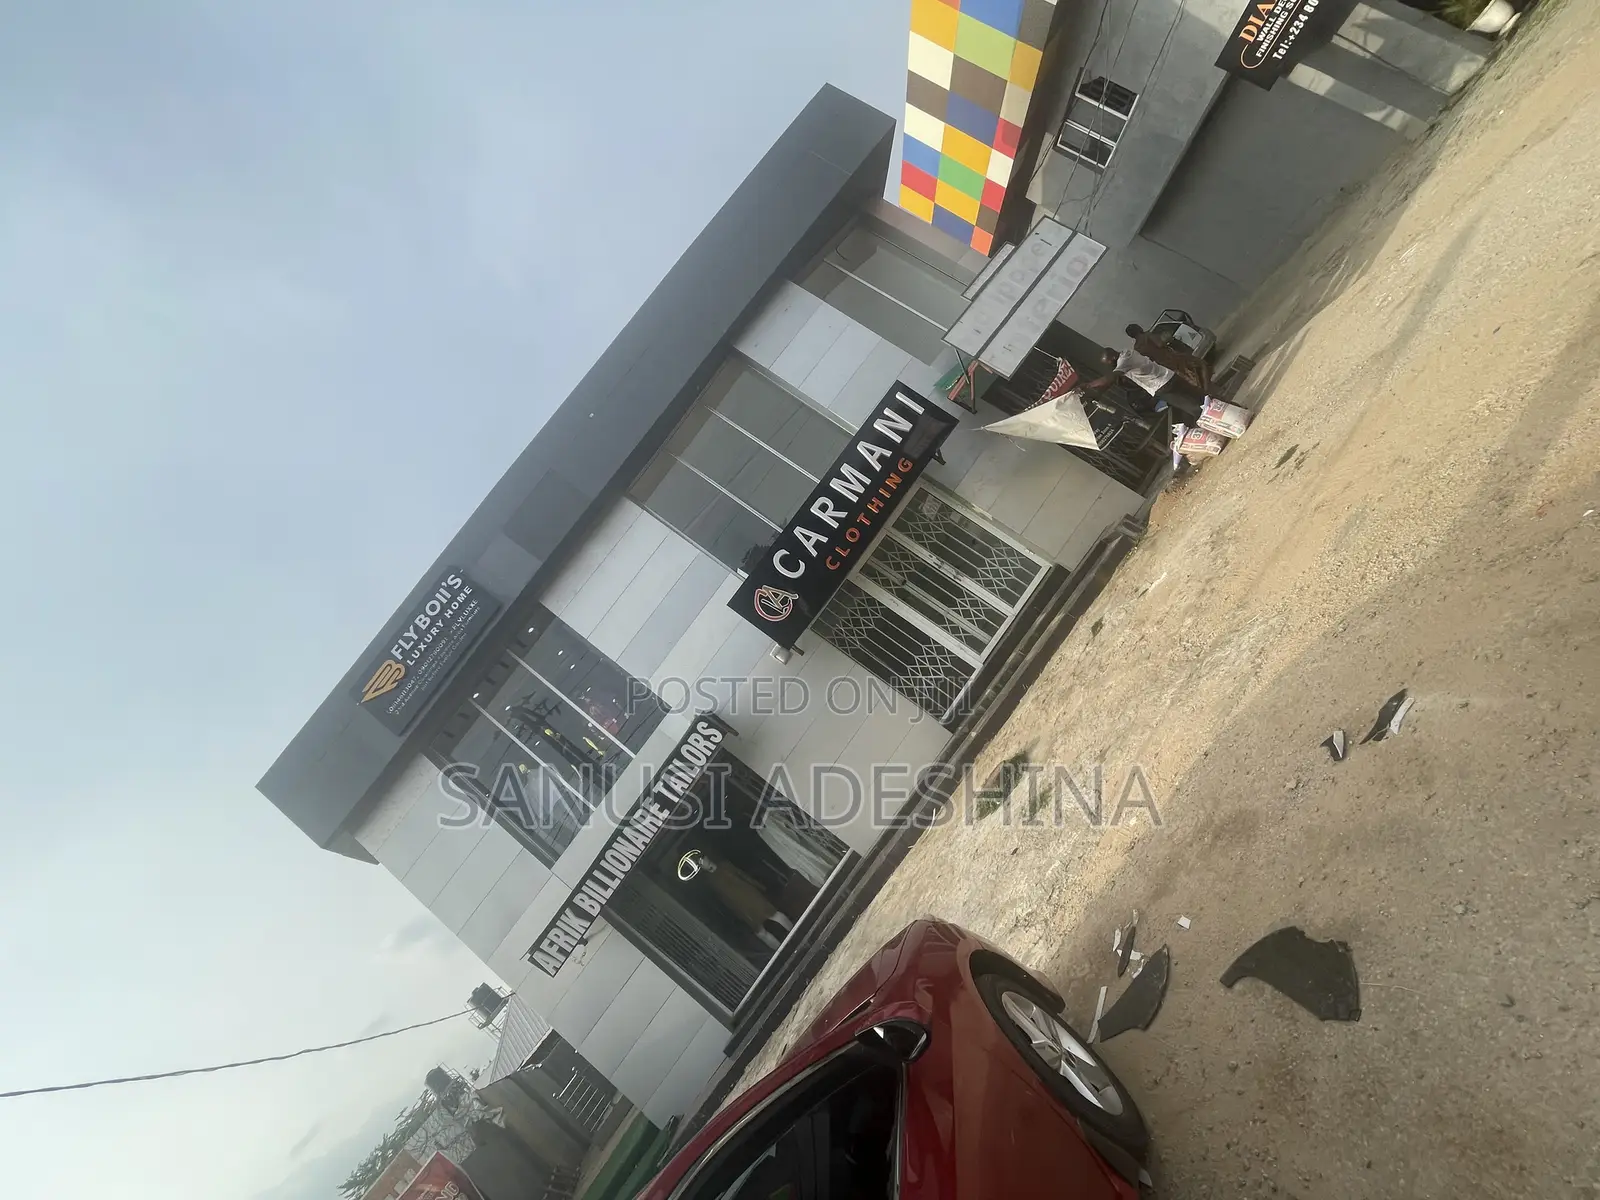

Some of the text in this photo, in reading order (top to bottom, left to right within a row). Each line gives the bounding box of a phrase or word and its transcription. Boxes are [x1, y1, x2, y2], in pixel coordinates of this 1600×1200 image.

[1239, 0, 1277, 43] DIA
[1255, 11, 1288, 57] FINISHING
[1256, 0, 1288, 41] WALL DE
[772, 391, 925, 579] CARMANI
[825, 457, 913, 570] CLOTHING
[406, 619, 444, 665] LUXURY
[444, 585, 472, 618] HOME
[531, 721, 724, 976] AFRIK BILLIONAIRE TAILORS
